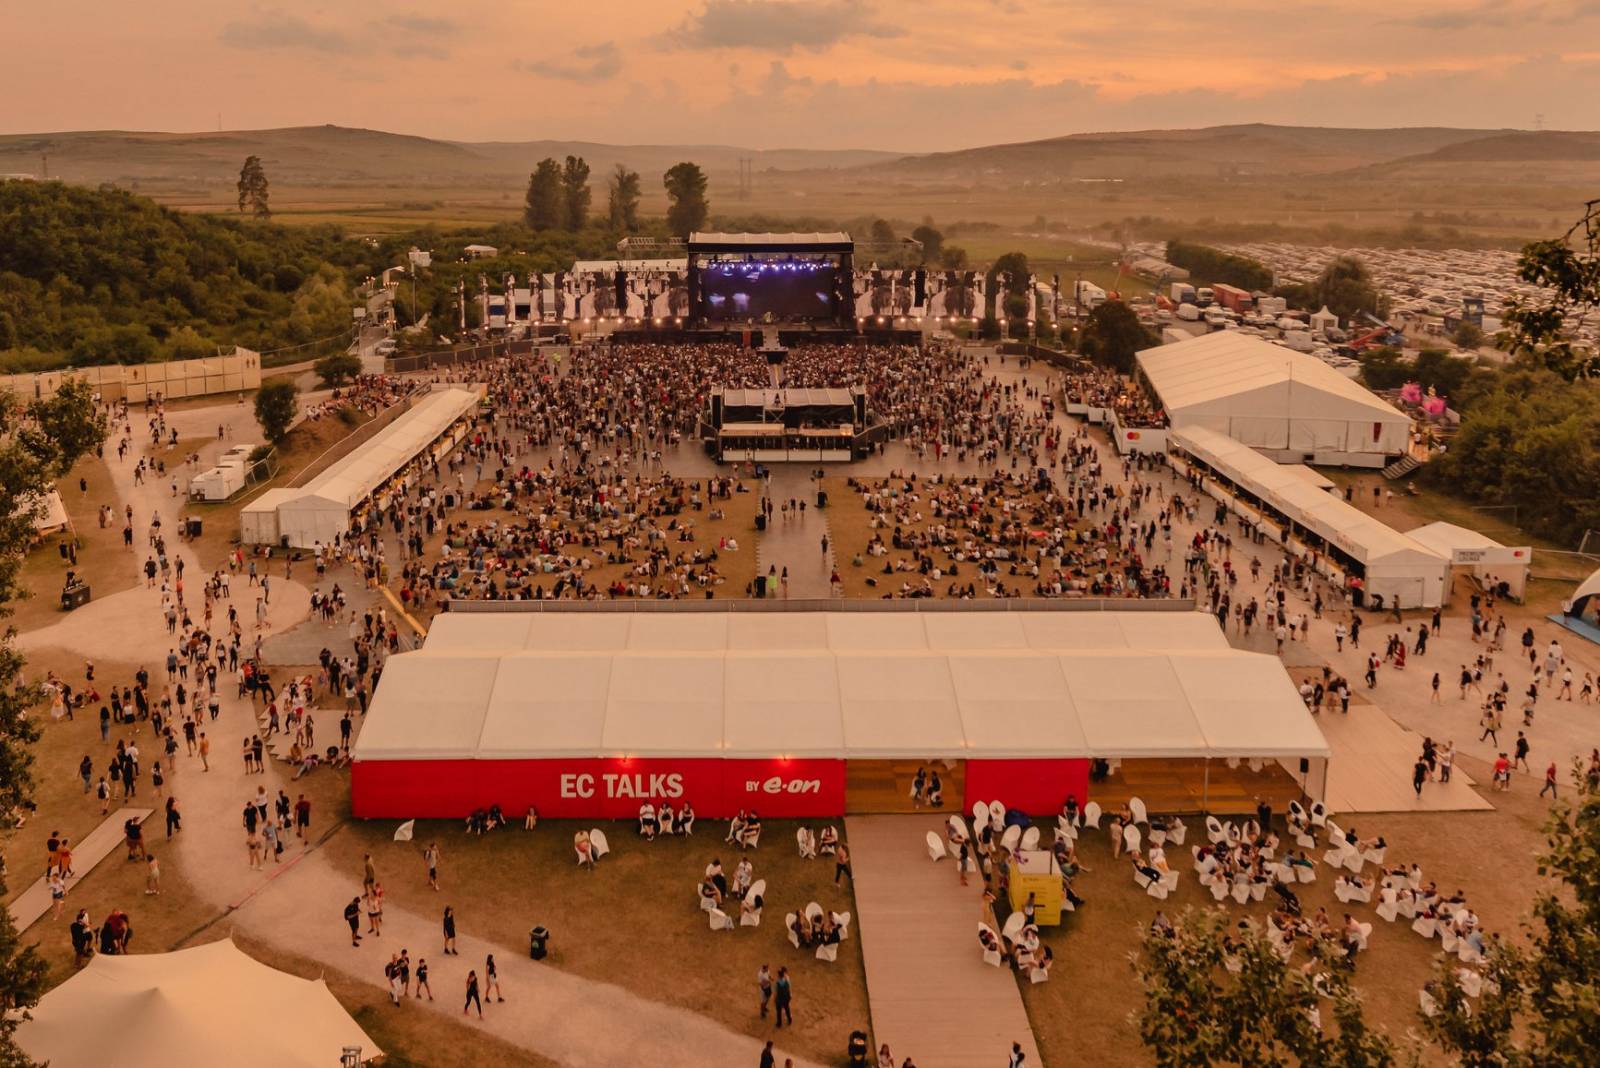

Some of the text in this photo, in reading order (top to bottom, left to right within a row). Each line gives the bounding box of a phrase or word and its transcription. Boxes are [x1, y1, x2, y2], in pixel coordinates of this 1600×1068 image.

[560, 773, 595, 798] EC
[602, 773, 684, 798] TALKS
[745, 781, 760, 792] BY
